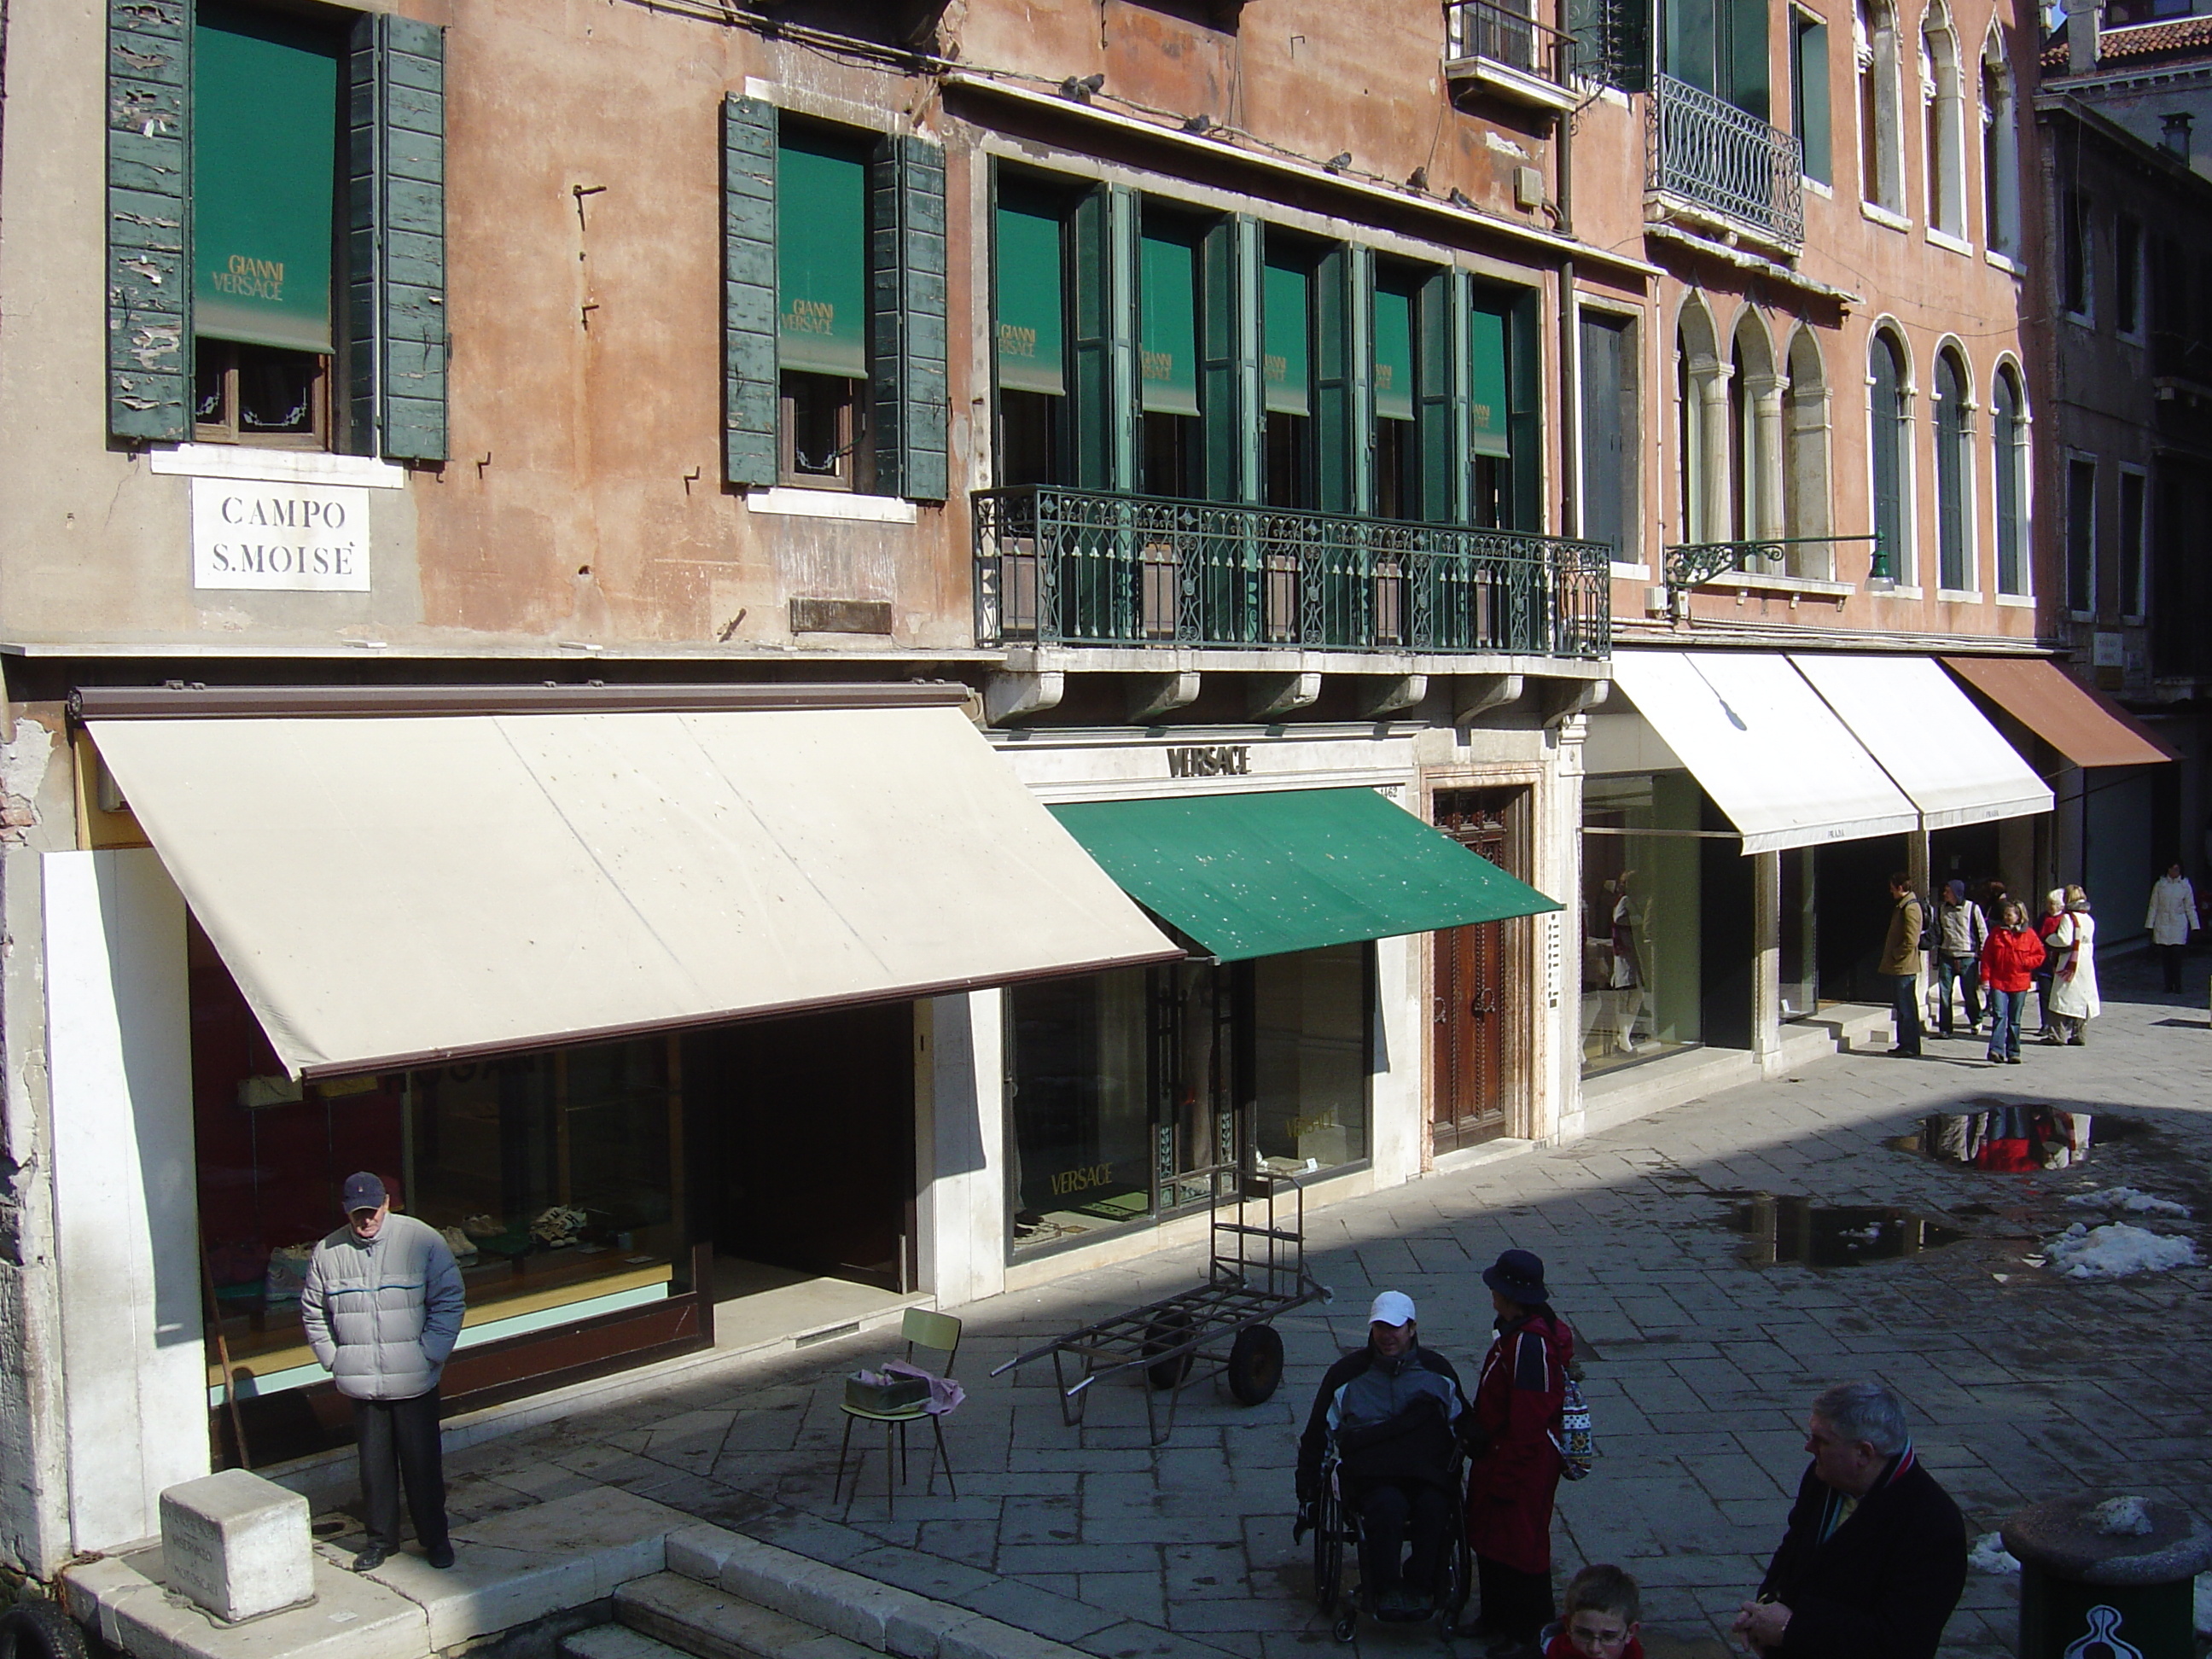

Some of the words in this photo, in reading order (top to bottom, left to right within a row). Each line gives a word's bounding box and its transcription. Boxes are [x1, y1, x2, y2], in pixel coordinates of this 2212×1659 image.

[228, 254, 283, 282] GIANNI
[212, 271, 283, 301] VERSACE
[793, 299, 833, 319] GIANNI
[781, 312, 833, 335] VERSACE
[1001, 323, 1035, 343] GIANNI
[998, 338, 1035, 358] ERSACE
[221, 496, 346, 529] CAMPO
[1166, 745, 1252, 778] VERSACE
[1051, 1161, 1113, 1196] VERSACE
